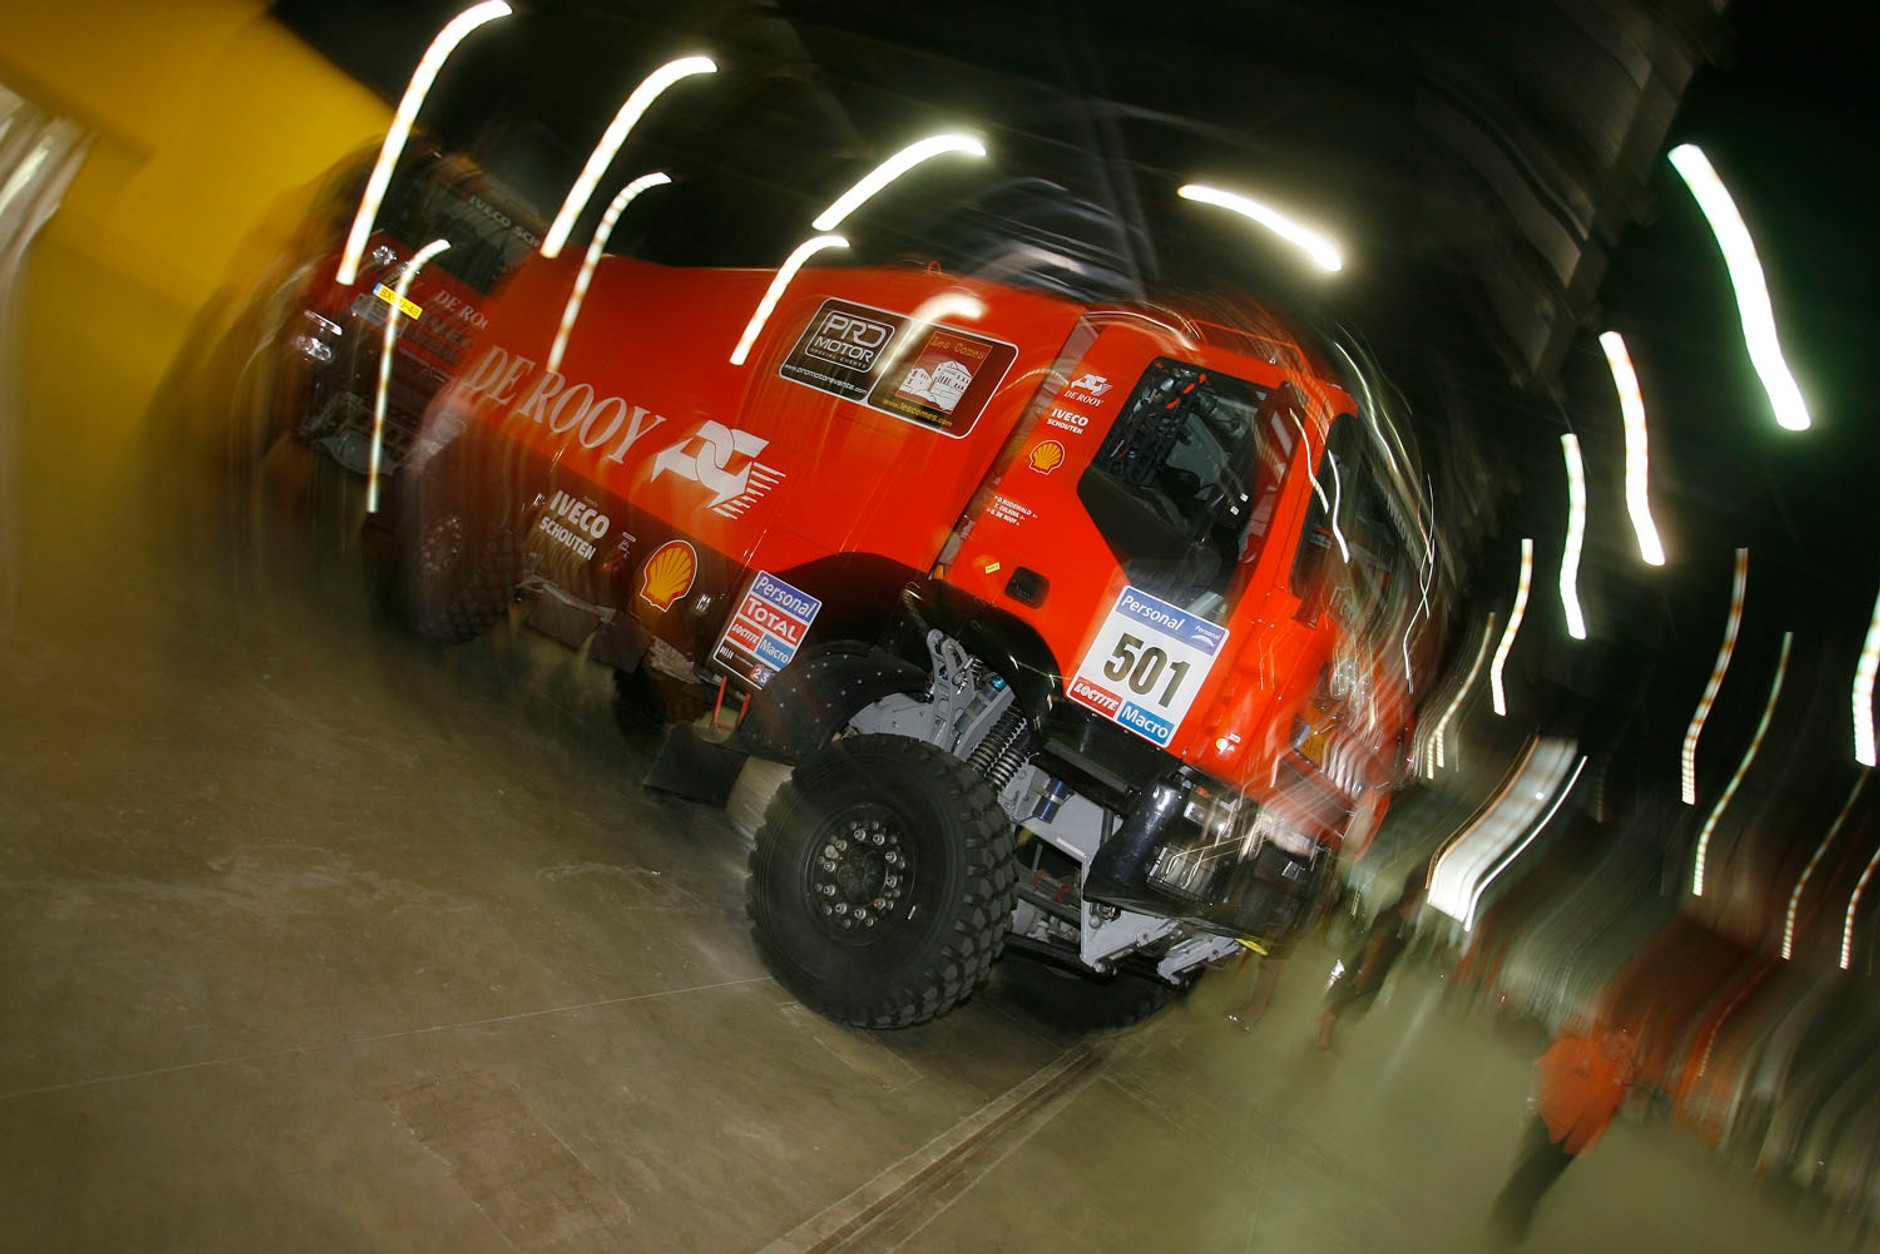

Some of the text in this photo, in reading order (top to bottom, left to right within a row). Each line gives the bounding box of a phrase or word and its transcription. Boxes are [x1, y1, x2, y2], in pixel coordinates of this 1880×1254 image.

[433, 289, 456, 312] DE
[814, 336, 874, 362] MOTOR
[465, 345, 667, 464] DE ROOY
[1064, 389, 1104, 407] DE ROOY
[1046, 418, 1084, 434] SCHOUTEN
[1051, 408, 1089, 426] IVECO
[550, 489, 610, 539] IVECO
[539, 516, 596, 560] SCHOUTEN
[756, 577, 817, 618] Personal
[746, 600, 797, 642] TOTAL
[1121, 595, 1185, 631] Personal
[732, 623, 760, 644] LOCTITE
[1194, 625, 1221, 641] Personal
[760, 640, 789, 663] Macro
[1103, 632, 1191, 708] 501
[1073, 682, 1119, 712] LOCTITE
[1121, 705, 1169, 739] Macro
